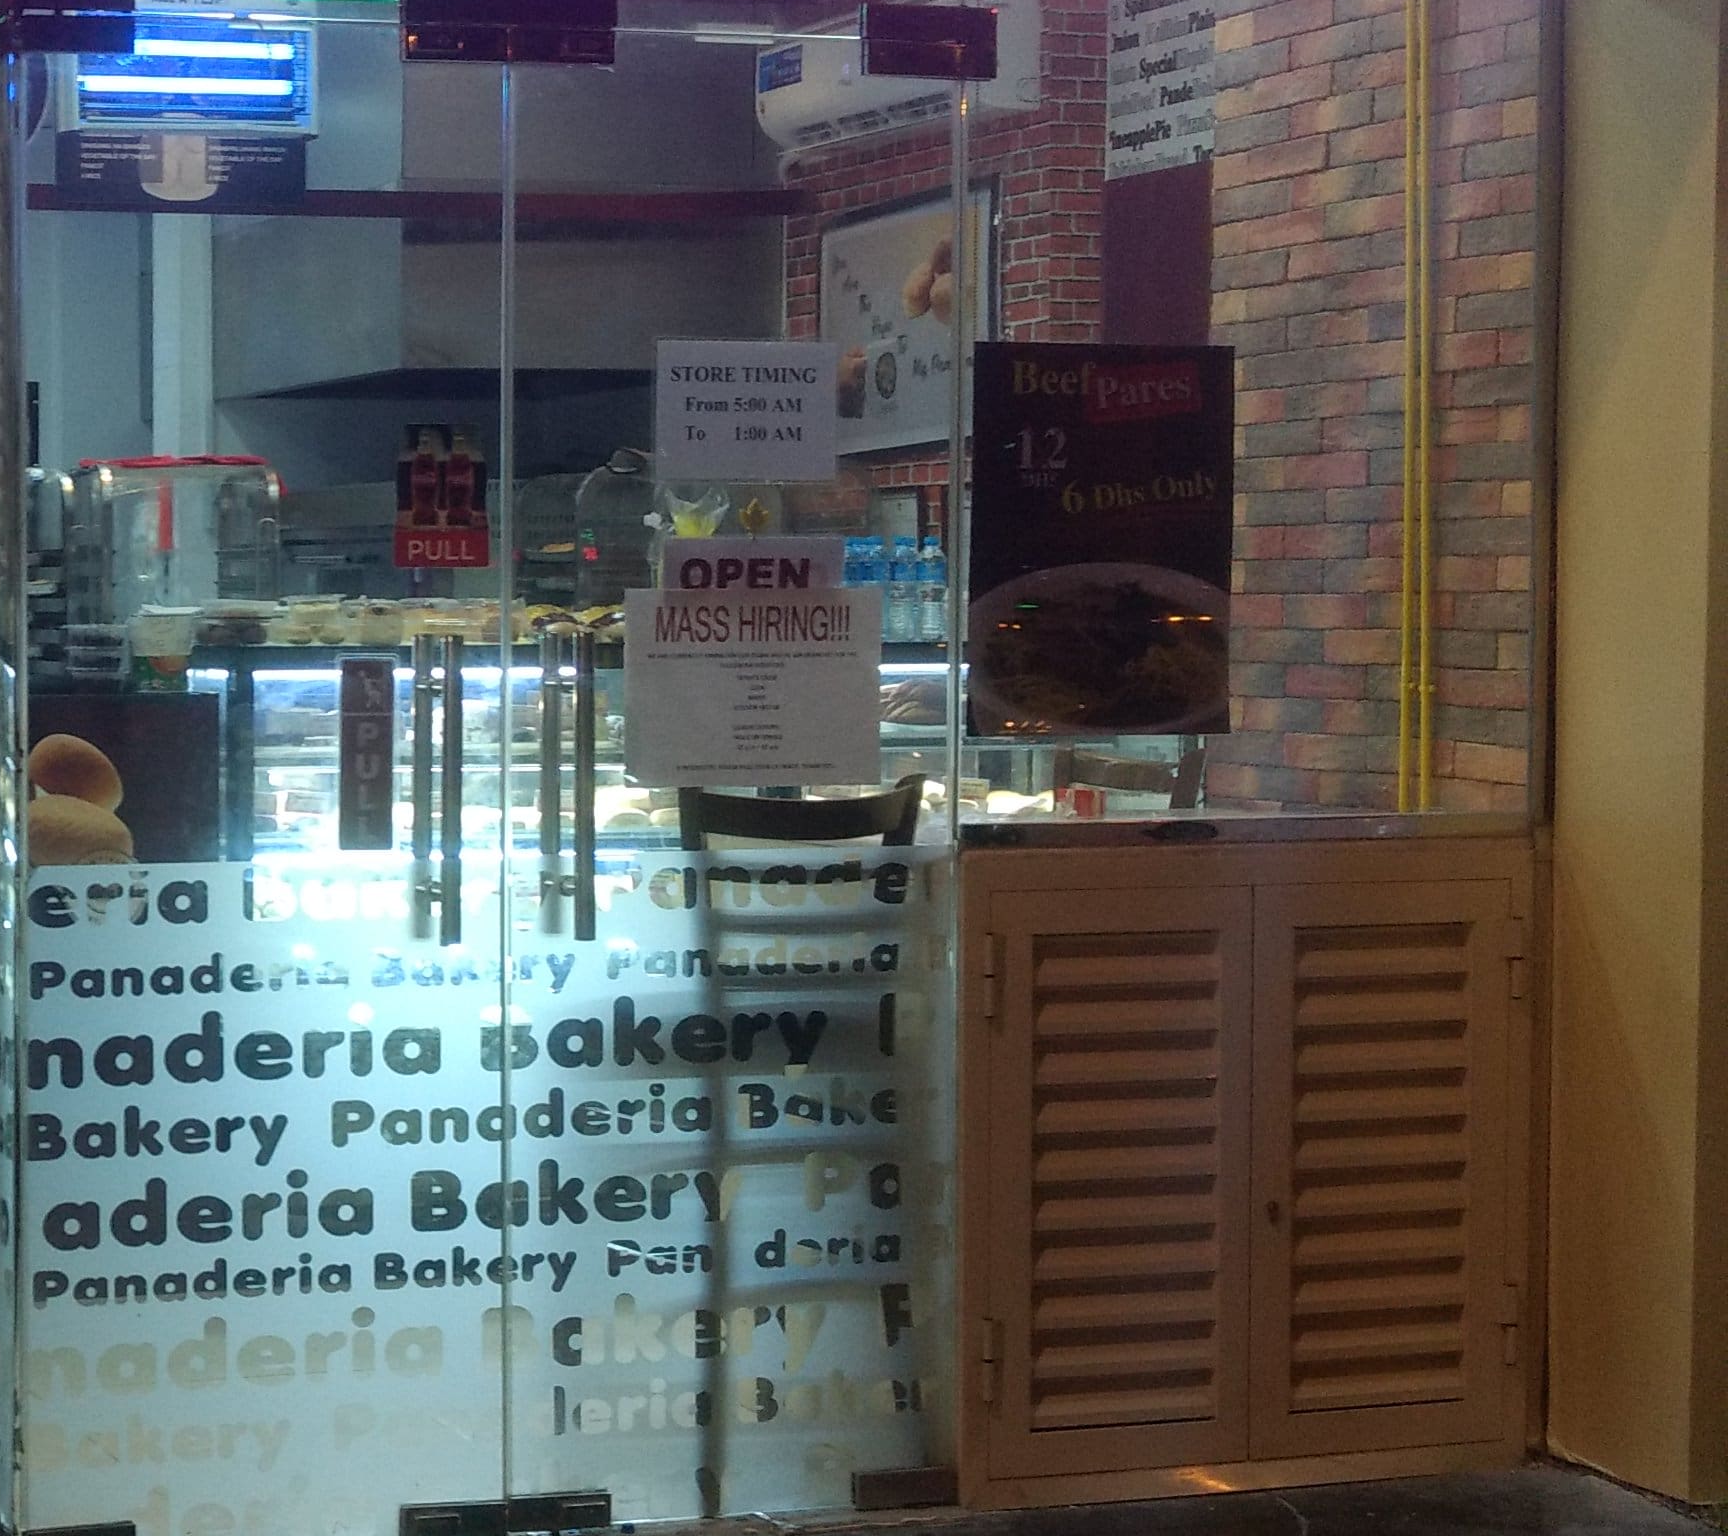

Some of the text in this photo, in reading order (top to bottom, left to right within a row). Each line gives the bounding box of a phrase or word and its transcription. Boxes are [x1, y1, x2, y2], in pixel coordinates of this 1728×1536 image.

[670, 366, 817, 384] STORE TIMING
[1013, 361, 1191, 409] Beef Pares
[685, 396, 802, 413] From 5:00 AM
[685, 425, 802, 442] To 1:00 AM
[408, 538, 476, 563] PULL
[680, 556, 812, 590] OPEN
[655, 605, 851, 643] MASS HIRING!!!
[480, 995, 829, 1077] Bakery
[27, 1105, 289, 1166] Bakery
[330, 1082, 714, 1148] Panaderia
[42, 1168, 375, 1251] aderia
[409, 1158, 745, 1236] Bakery
[32, 1226, 902, 1309] Panaderia Bakery Panderia
[480, 1292, 829, 1372] Bakery
